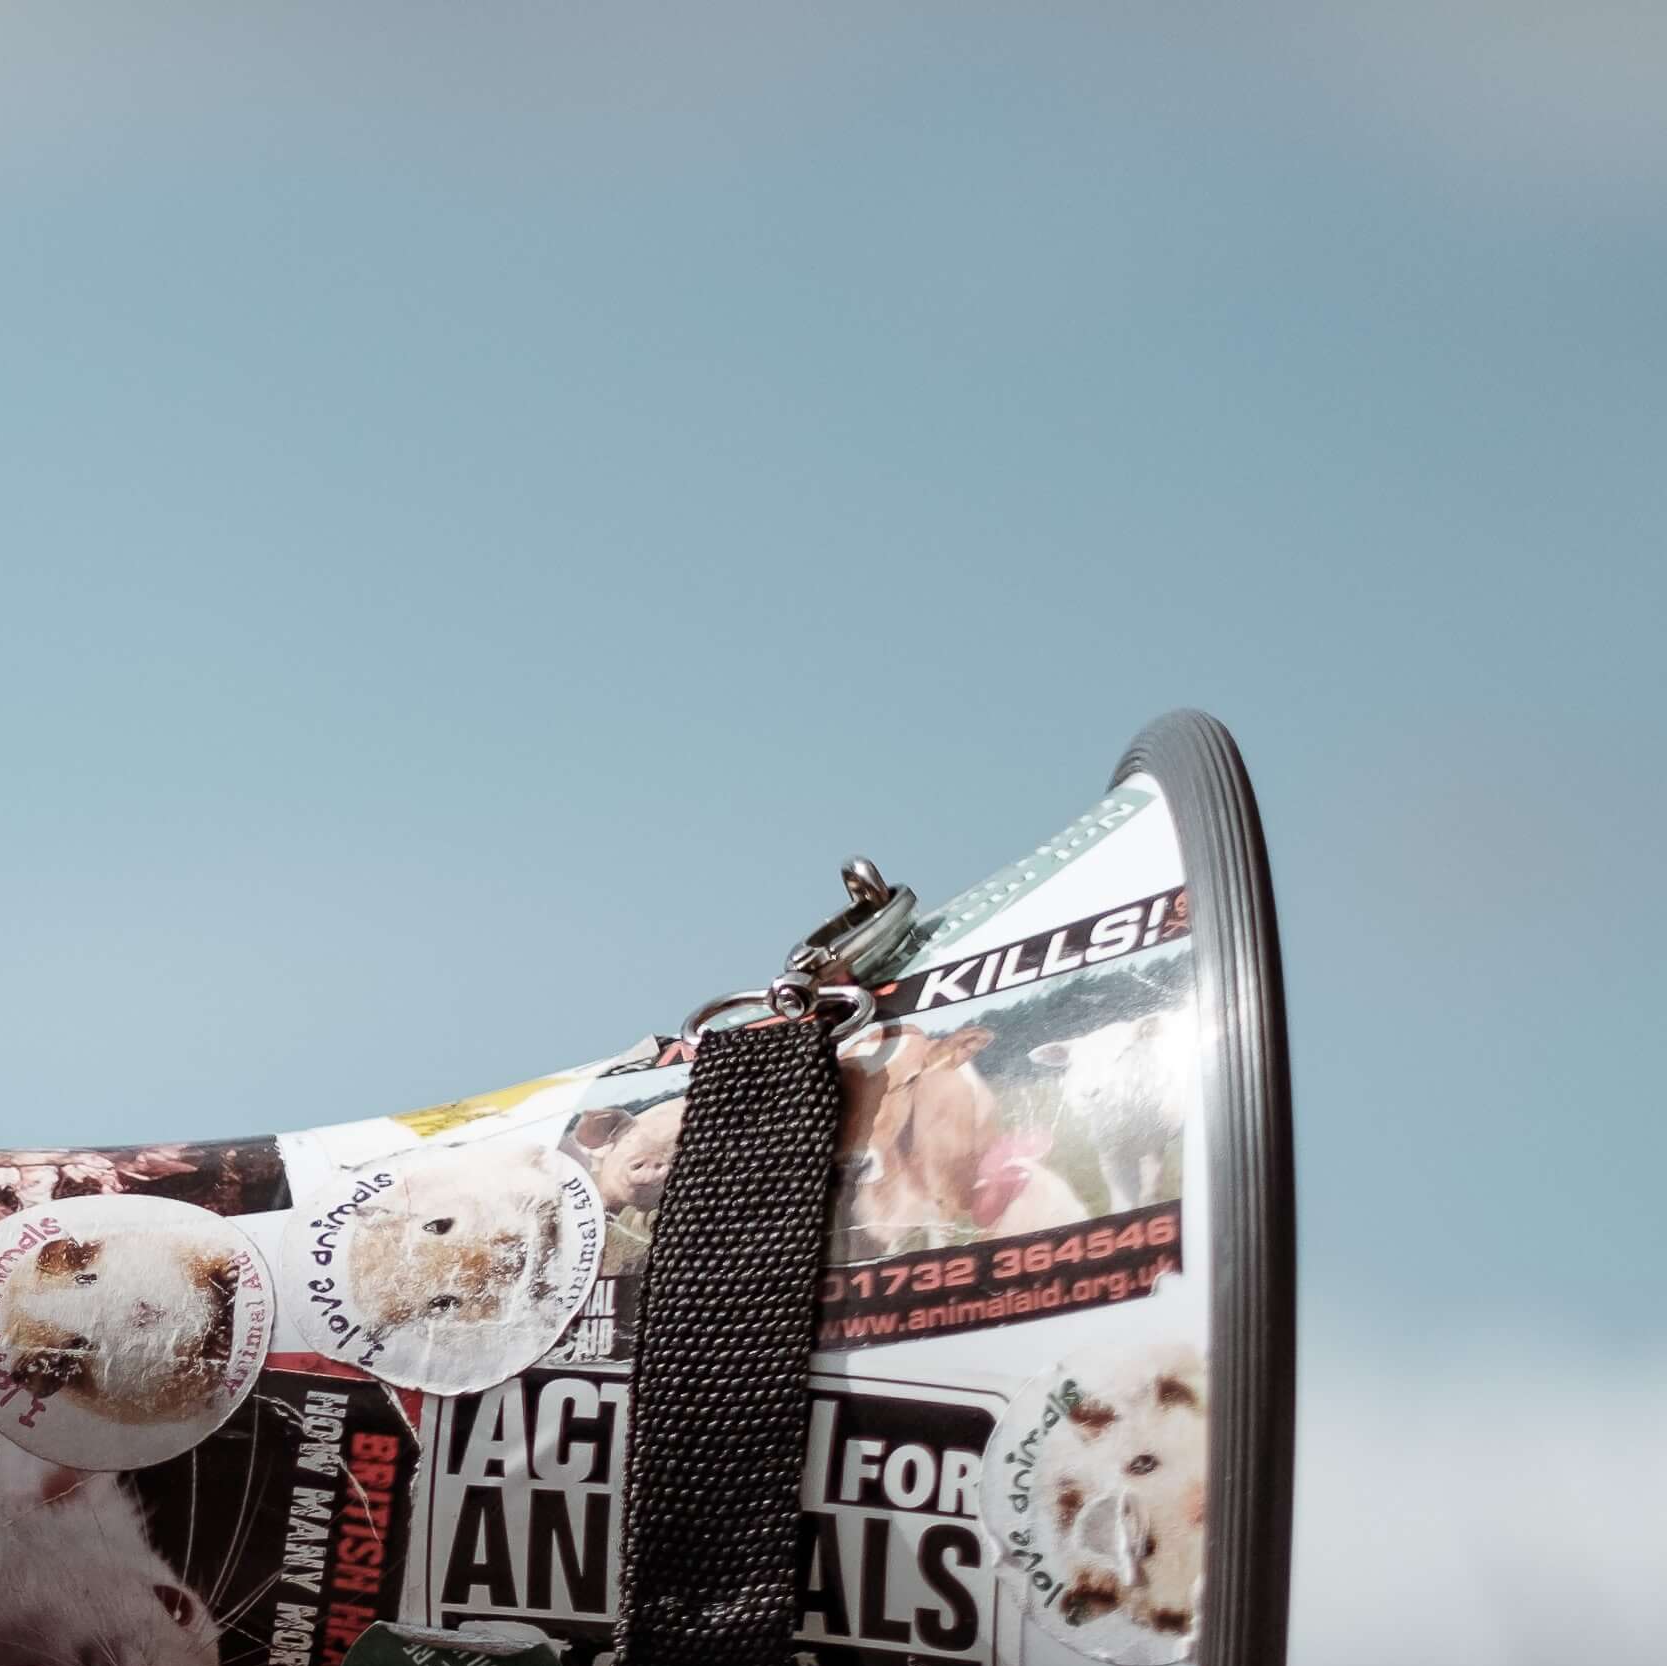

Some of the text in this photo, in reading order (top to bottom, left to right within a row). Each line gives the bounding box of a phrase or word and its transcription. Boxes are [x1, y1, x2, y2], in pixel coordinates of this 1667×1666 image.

[915, 896, 1168, 1010] KILLS!
[310, 1172, 395, 1267] animals
[992, 1216, 1178, 1278] 364546
[307, 1277, 361, 1350] love
[19, 1392, 47, 1429] I
[296, 1390, 349, 1478] HOW
[332, 1432, 400, 1593] BRITISH
[839, 1438, 980, 1517] FOR
[280, 1486, 336, 1594] MANY
[1008, 1529, 1065, 1609] love
